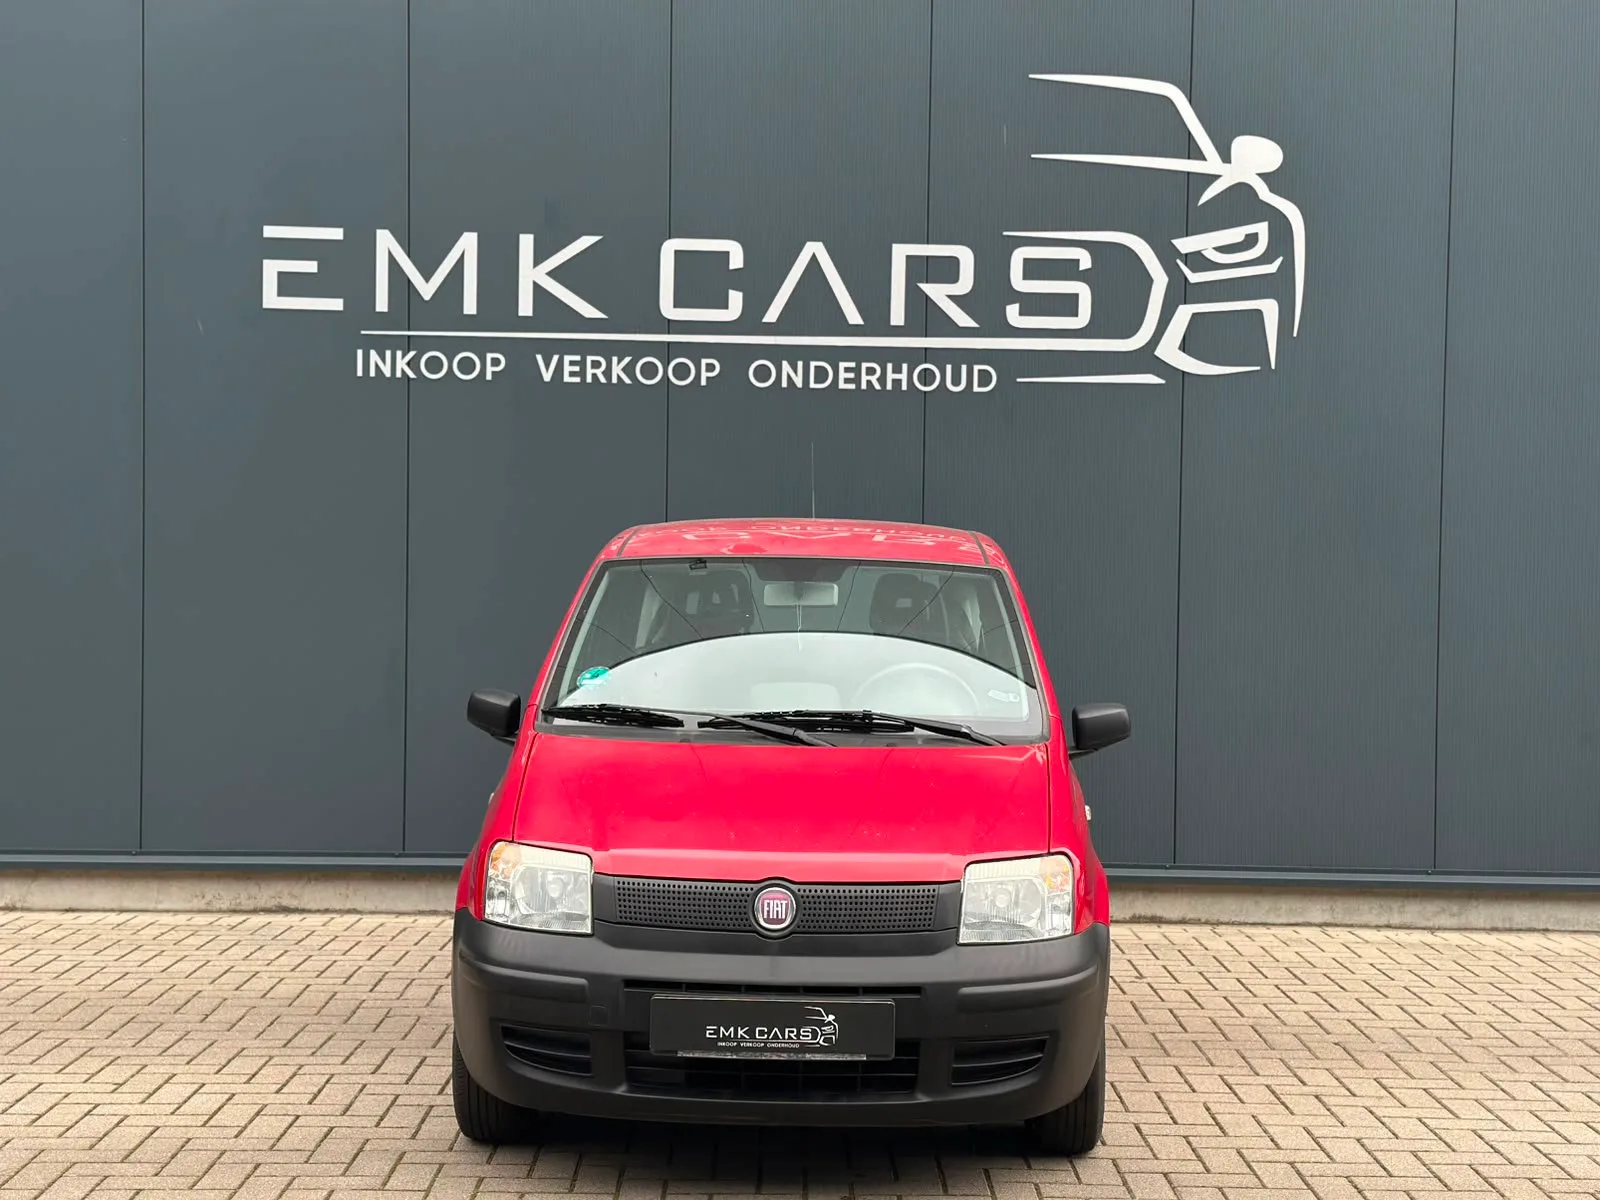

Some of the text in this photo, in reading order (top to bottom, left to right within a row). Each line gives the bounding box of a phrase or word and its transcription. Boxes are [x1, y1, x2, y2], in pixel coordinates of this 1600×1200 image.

[262, 225, 1092, 330] EMK CARS
[356, 348, 997, 393] INKOOP VERKOOP ONDERHOUD
[763, 899, 788, 920] FIAT
[705, 1025, 812, 1040] EMK CARS
